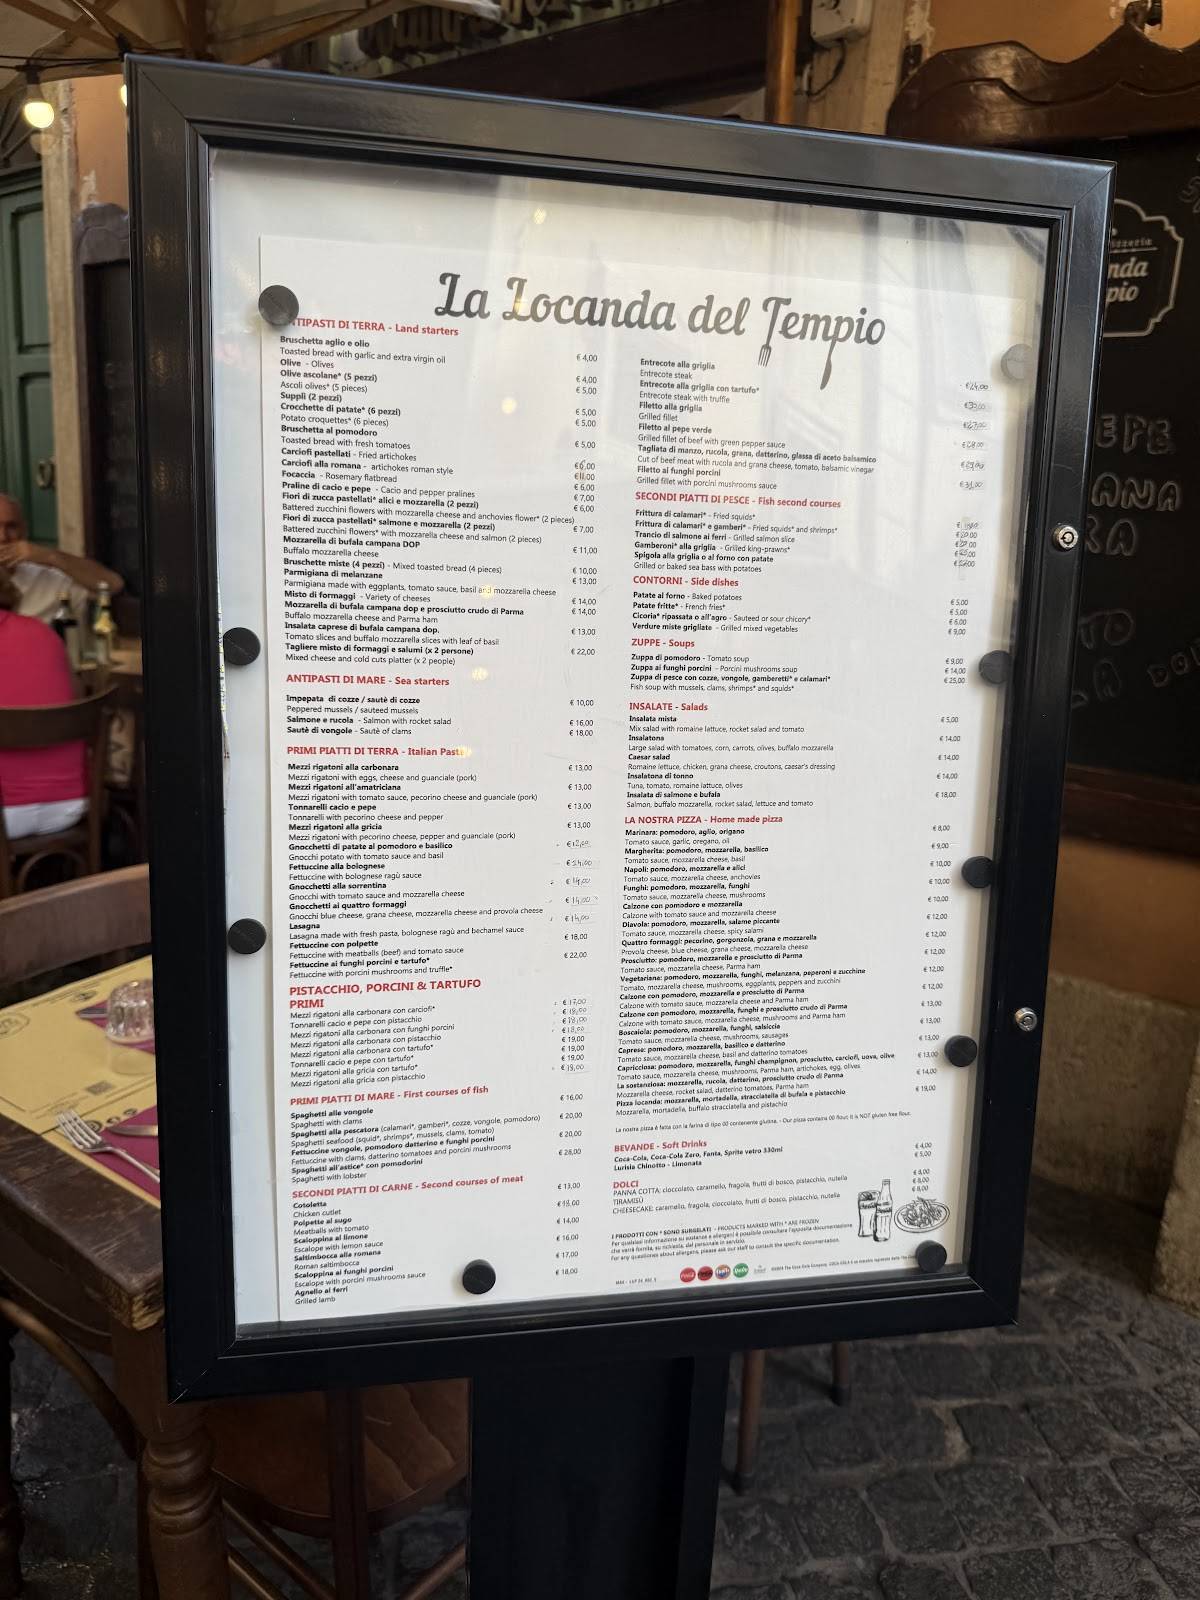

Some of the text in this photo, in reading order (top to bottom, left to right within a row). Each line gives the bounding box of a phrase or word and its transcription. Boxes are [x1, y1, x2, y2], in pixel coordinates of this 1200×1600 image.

[290, 317, 336, 332] TIPASTI
[338, 320, 350, 329] DI
[351, 320, 386, 332] TERRA
[395, 323, 419, 334] Land
[421, 326, 459, 336] starters
[434, 272, 887, 380] La Locanda del Tempio
[280, 335, 324, 345] Bruschetta
[324, 338, 346, 348] aglio
[354, 339, 370, 348] olio
[279, 346, 446, 365] Toasted bread with garlic and extra virgin oil
[576, 352, 598, 363] € 4,00
[640, 358, 715, 371] Entrecote alla griglia
[281, 424, 378, 437] Bruschetta al pomodoro
[635, 491, 677, 502] SECONDI
[678, 493, 709, 503] PIATTI
[710, 494, 721, 504] DI
[723, 495, 750, 505] PESCE
[758, 496, 775, 506] Fish
[776, 498, 808, 507] second
[809, 500, 841, 508] courses
[283, 535, 420, 548] Mozzarella di bufala campana DOP
[572, 546, 598, 556] € 11,00
[283, 568, 383, 579] Parmigiana di melanzane
[633, 575, 683, 585] CONTORNI
[690, 577, 710, 586] Side
[711, 577, 739, 587] dishes
[631, 638, 661, 647] ZUPPE
[668, 638, 695, 649] Soups
[945, 657, 964, 666] € 9,00
[286, 674, 341, 684] ANTIPASTI
[342, 675, 354, 684] DI
[356, 675, 386, 685] MARE
[394, 676, 412, 685] Sea
[413, 677, 450, 686] starters
[629, 702, 673, 711] INSALATE
[680, 702, 708, 711] Salads
[287, 746, 317, 755] PRIMI
[319, 746, 352, 755] PIATTI
[354, 746, 365, 755] DI
[366, 747, 399, 756] TERRA
[407, 747, 438, 756] Italian
[312, 763, 344, 772] rigatoni
[345, 763, 359, 771] alla
[360, 763, 399, 771] carbonara
[568, 764, 593, 772] € 13,00
[287, 803, 328, 811] Tonnarelli
[329, 803, 349, 811] cacio
[624, 816, 636, 824] LA
[638, 816, 675, 824] NOSTRA
[676, 815, 702, 824] PIZZA
[710, 815, 736, 823] Home
[737, 815, 760, 823] made
[761, 814, 783, 825] pizza
[622, 902, 650, 910] Calzone
[664, 901, 700, 910] pomodoro
[707, 900, 743, 908] mozzarella
[931, 912, 948, 921] 12,00
[289, 923, 321, 931] Lasagna
[564, 933, 588, 941] € 18,00
[289, 941, 329, 949] Fettuccine
[346, 940, 379, 949] polpette
[289, 978, 481, 996] PISTACCHIO, PORCINI & TARTUFO
[289, 998, 324, 1009] PRIMI
[568, 1035, 585, 1043] 19,00
[290, 1096, 319, 1106] PRIMI
[320, 1094, 352, 1104] PIATTI
[354, 1093, 365, 1102] DI
[367, 1091, 395, 1101] MARE
[403, 1090, 424, 1098] First
[425, 1088, 459, 1097] courses
[460, 1086, 471, 1095] of
[472, 1085, 489, 1094] fish
[614, 1142, 655, 1153] BEVANDE
[662, 1140, 679, 1150] Soft
[681, 1139, 707, 1148] Drinks
[914, 1141, 933, 1150] € 4,00
[292, 1188, 335, 1199] SECONDI
[336, 1186, 367, 1196] PIATTI
[368, 1185, 380, 1193] DI
[381, 1182, 413, 1192] CARNE
[421, 1179, 454, 1189] Second
[455, 1178, 488, 1187] courses
[489, 1175, 500, 1184] of
[501, 1175, 524, 1183] meat
[612, 1180, 639, 1189] DOLCI
[293, 1235, 333, 1245] Scaloppina
[343, 1233, 368, 1241] limone
[294, 1296, 318, 1305] Grilled
